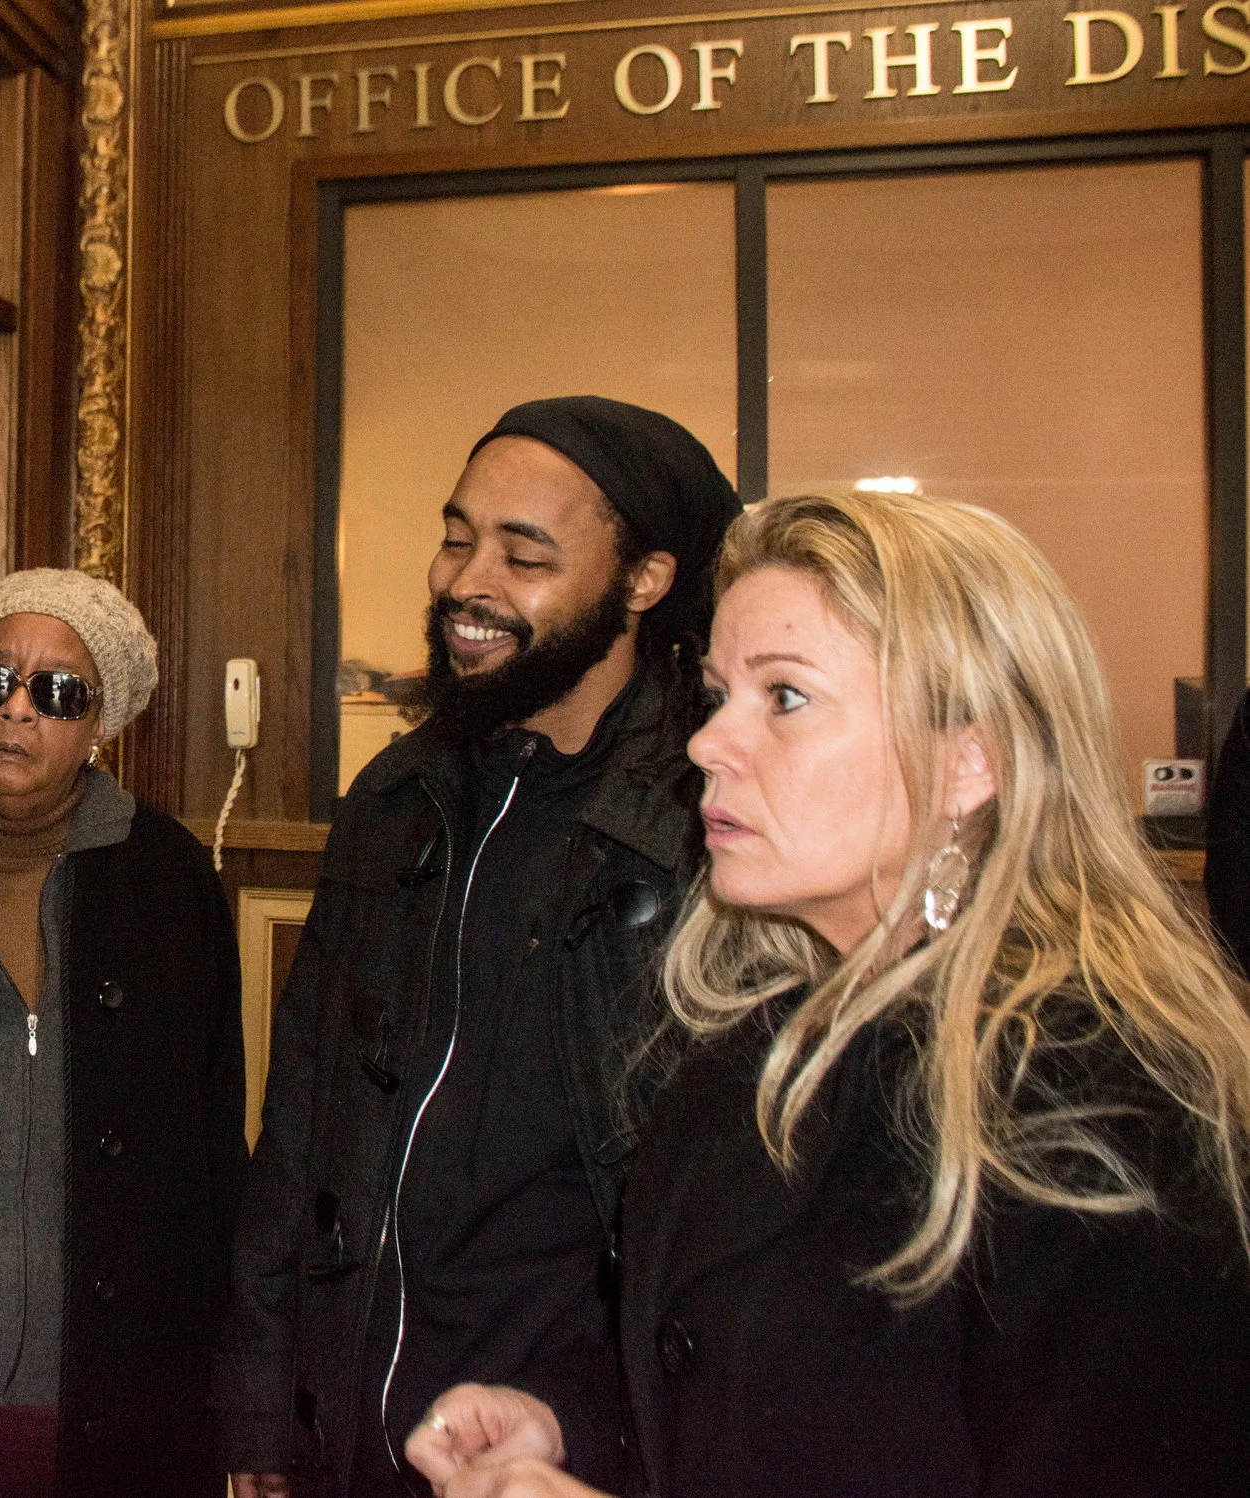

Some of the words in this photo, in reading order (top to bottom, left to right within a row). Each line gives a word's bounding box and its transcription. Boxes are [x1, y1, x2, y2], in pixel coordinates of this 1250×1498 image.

[224, 52, 571, 143] OFFICE
[614, 39, 744, 115] OF
[790, 17, 1019, 103] THE
[1063, 1, 1250, 86] DIS
